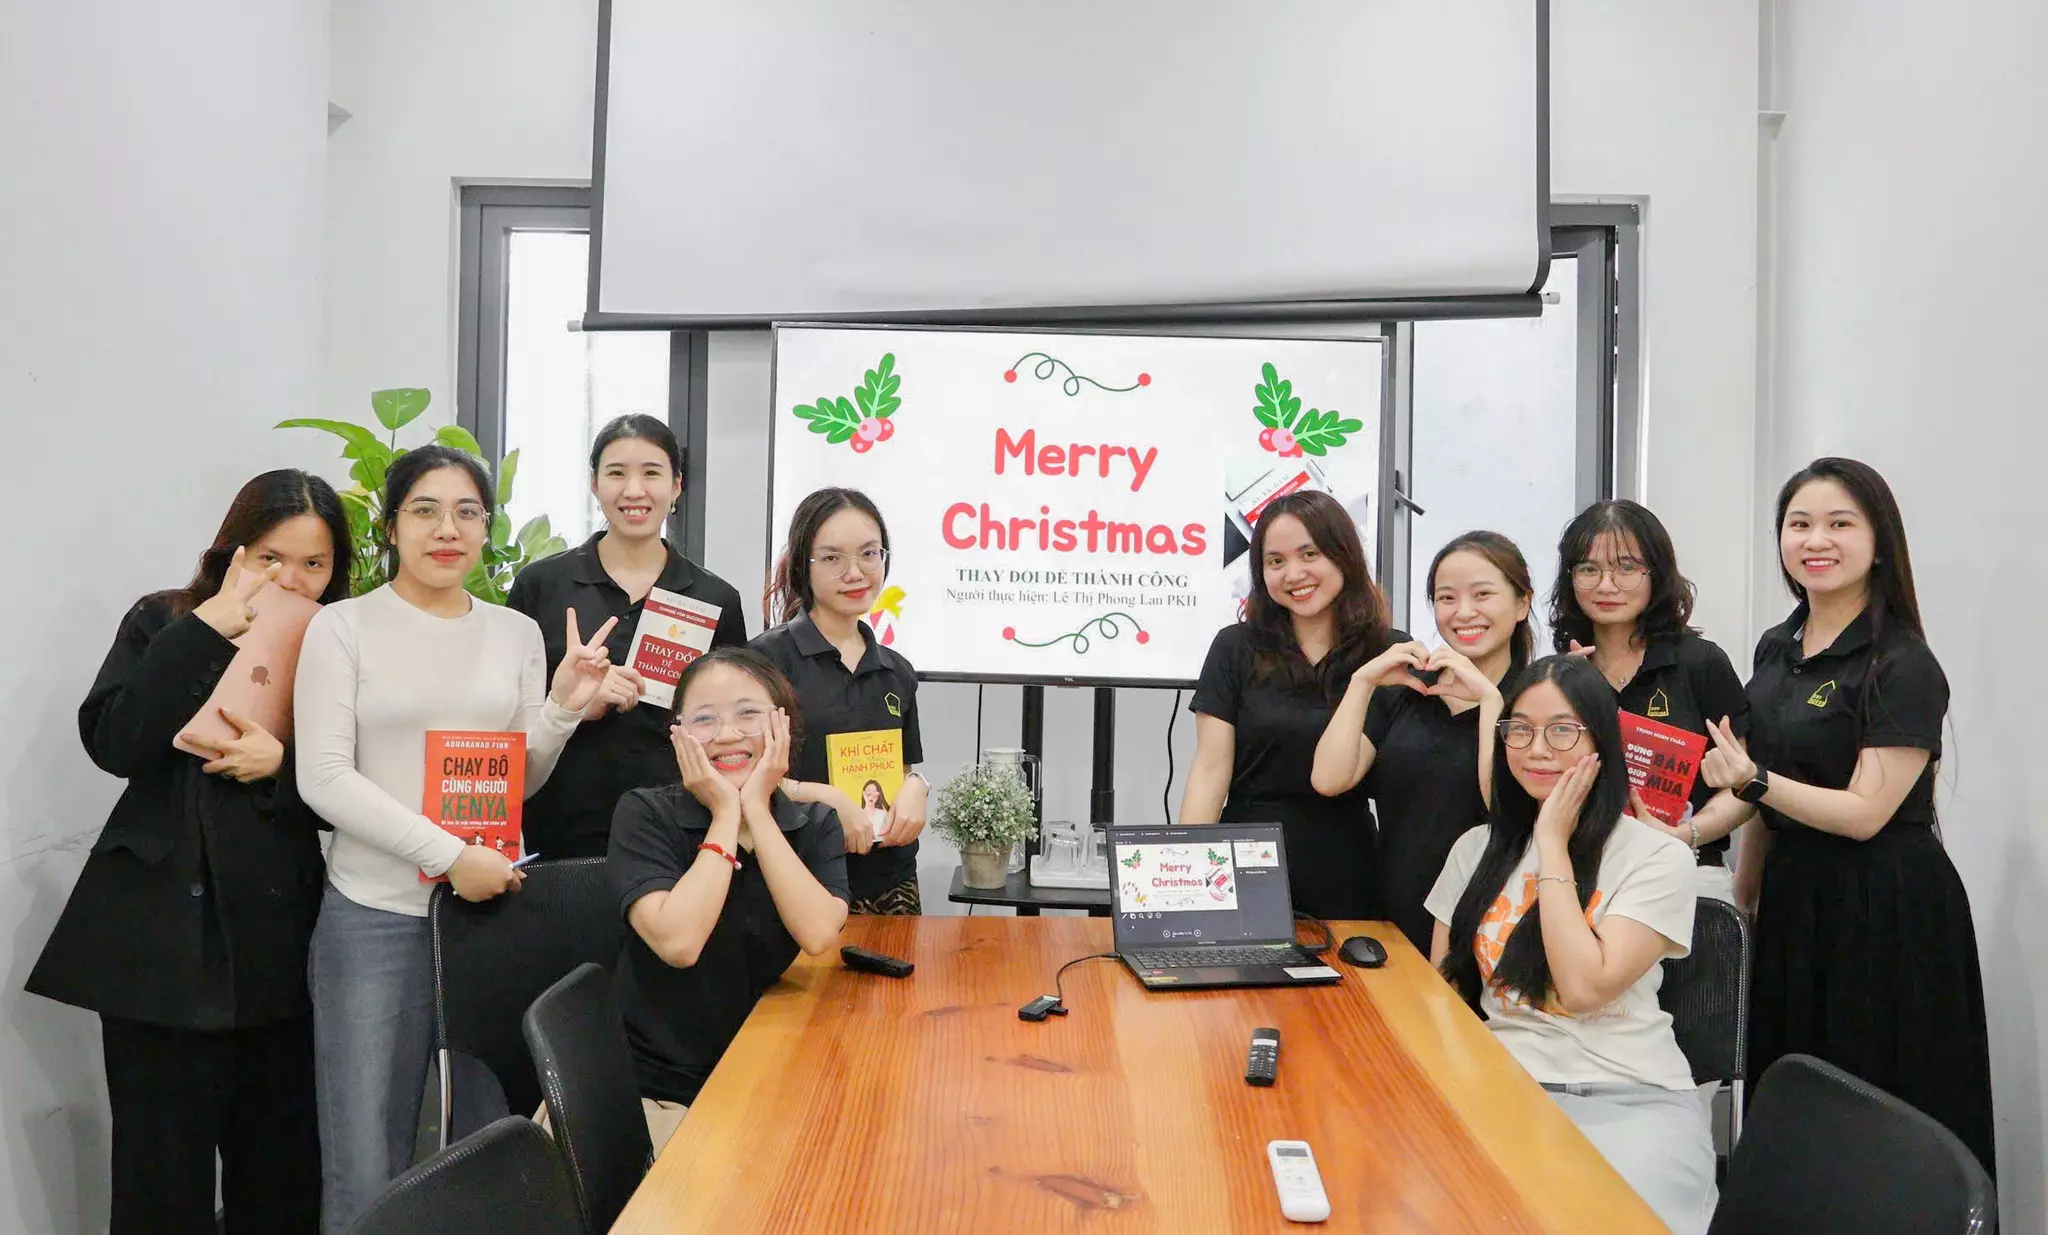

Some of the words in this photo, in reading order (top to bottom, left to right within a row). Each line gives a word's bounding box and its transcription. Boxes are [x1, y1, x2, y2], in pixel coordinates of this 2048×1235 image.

[994, 427, 1158, 492] Merry
[942, 502, 1207, 556] Christmas
[956, 567, 1005, 582] THAY
[1072, 568, 1133, 586] THÀNH
[1138, 570, 1189, 588] CÔNG
[946, 587, 985, 604] Người
[1098, 592, 1136, 608] Phong
[1140, 593, 1163, 606] Lan
[644, 641, 674, 658] THAY
[637, 661, 667, 675] THÀNH
[840, 743, 860, 758] KHÍ
[443, 757, 484, 779] CHẠY
[488, 755, 509, 779] BỘ
[441, 778, 472, 794] CÙNG
[474, 779, 508, 795] NGƯỜI
[1646, 774, 1682, 798] MUA
[441, 795, 508, 821] KENYA
[1159, 862, 1192, 875] Merry
[1151, 876, 1203, 889] Christmas
